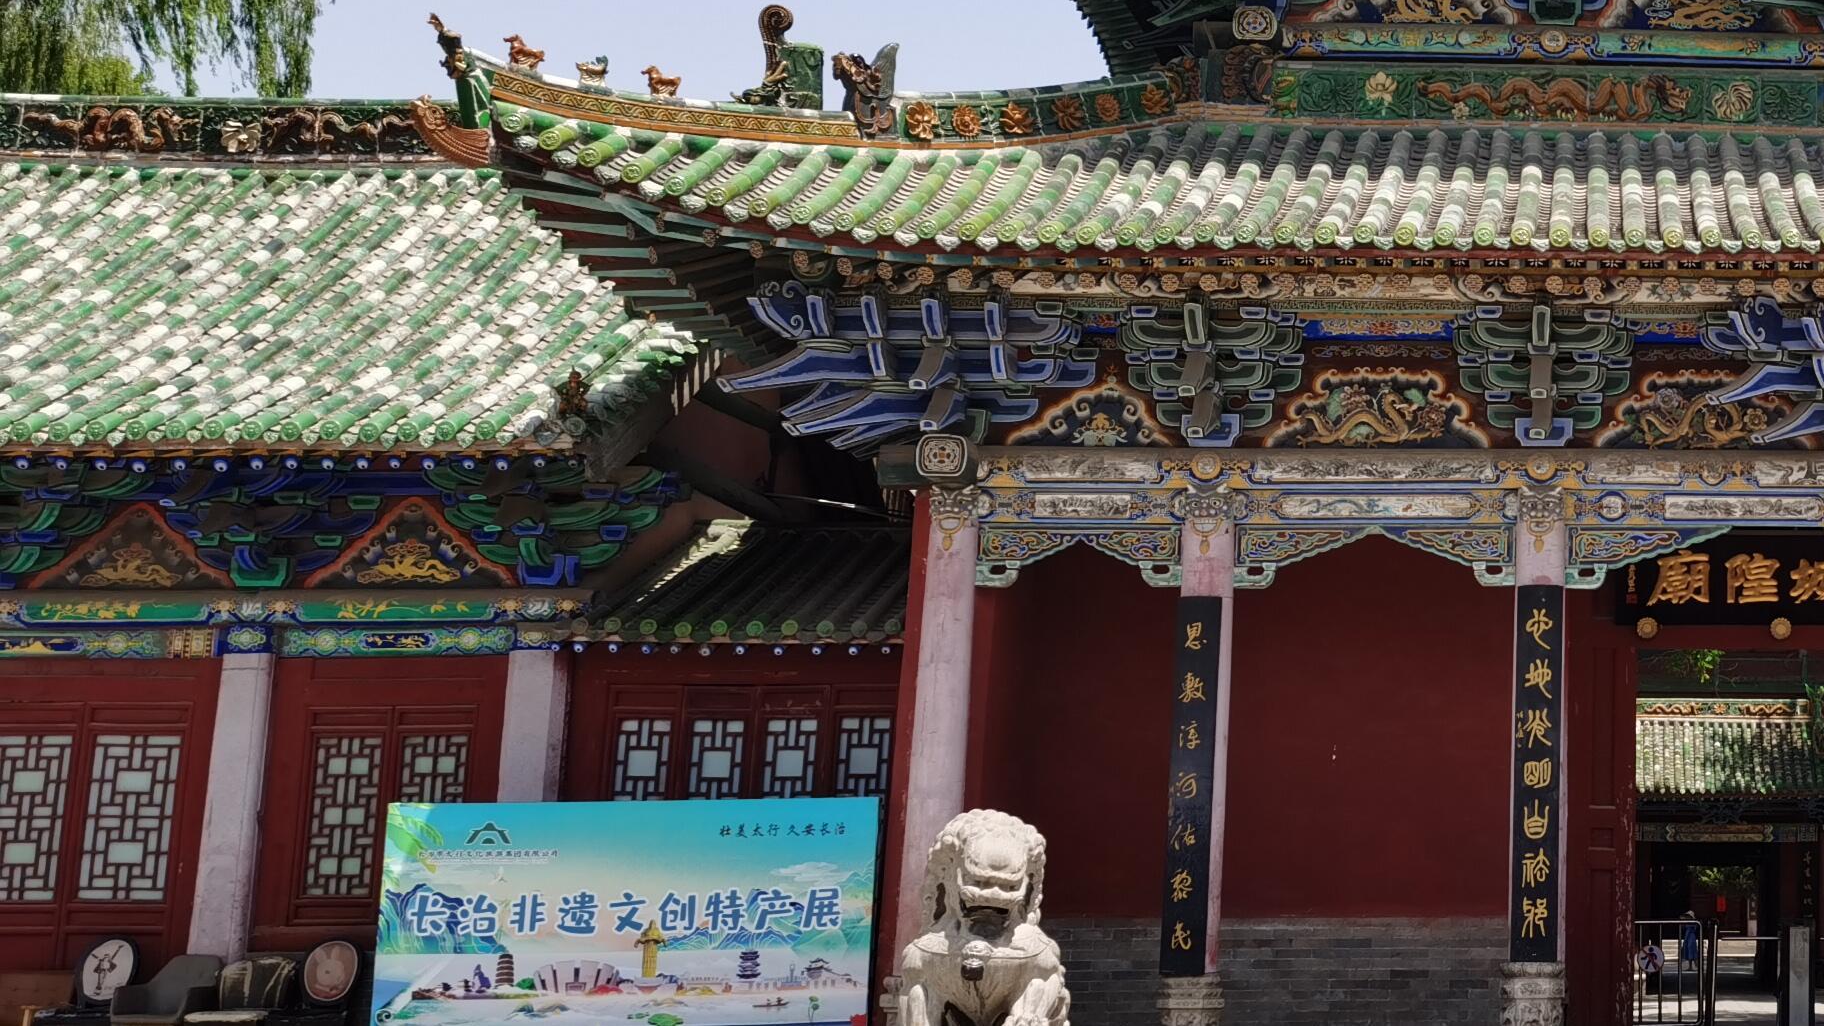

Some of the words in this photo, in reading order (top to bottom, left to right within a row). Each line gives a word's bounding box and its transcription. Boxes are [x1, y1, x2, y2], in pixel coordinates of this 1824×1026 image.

[719, 822, 780, 838] 壮美太行
[786, 821, 846, 837] 久安长治
[408, 887, 843, 937] 长治非遗文创特产展
